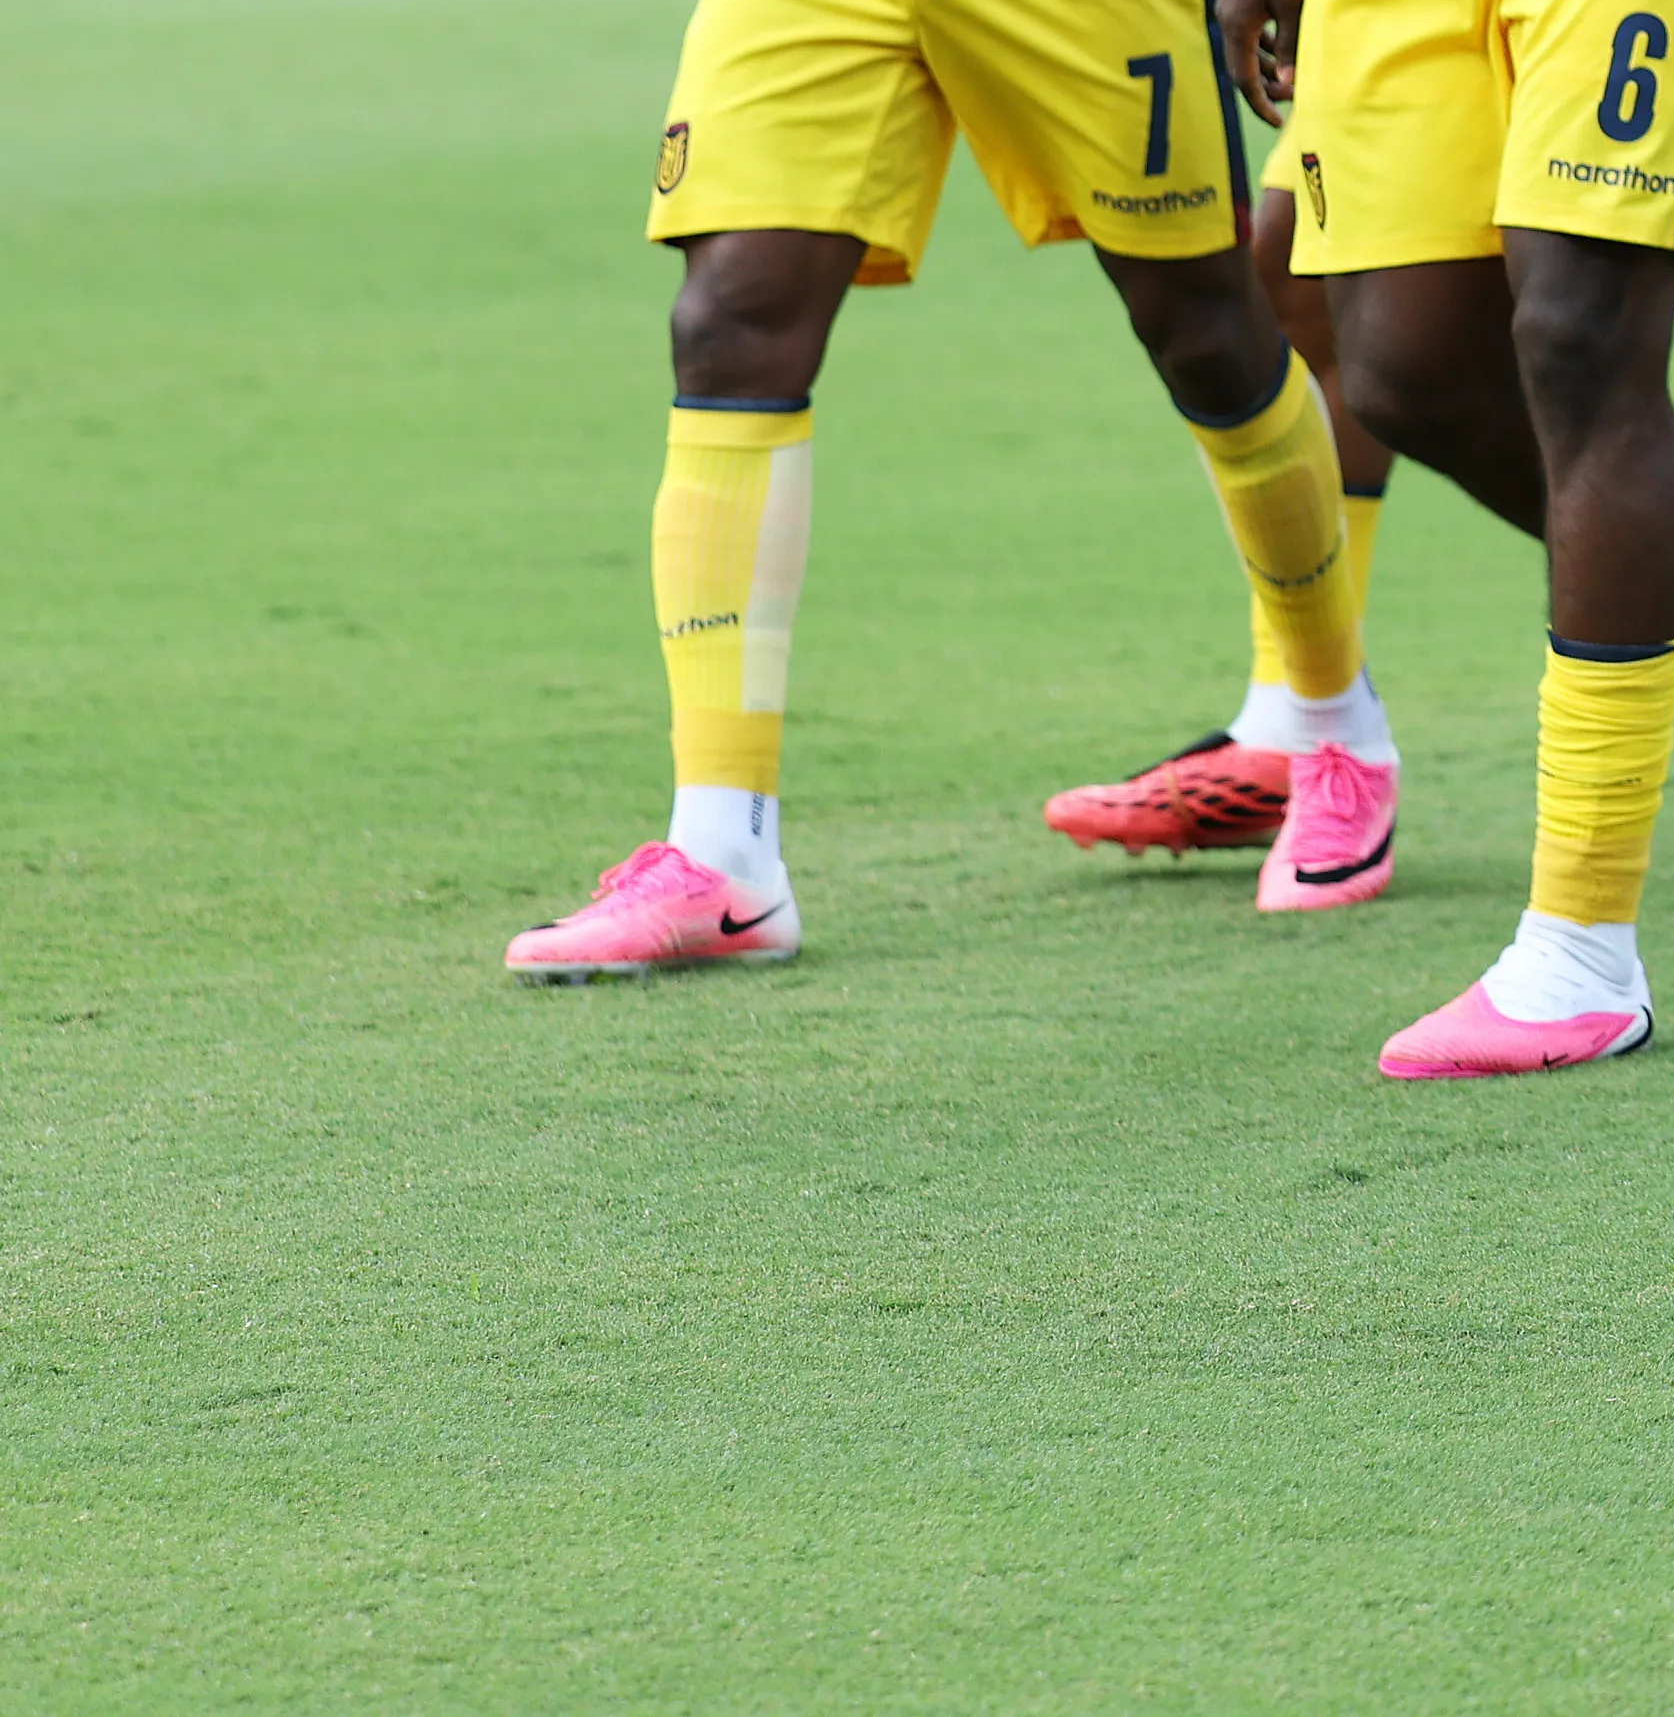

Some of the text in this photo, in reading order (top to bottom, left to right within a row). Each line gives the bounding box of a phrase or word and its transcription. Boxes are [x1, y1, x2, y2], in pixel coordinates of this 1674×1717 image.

[1127, 51, 1173, 177] 7
[1598, 11, 1668, 142] 6
[1093, 185, 1218, 217] marathon
